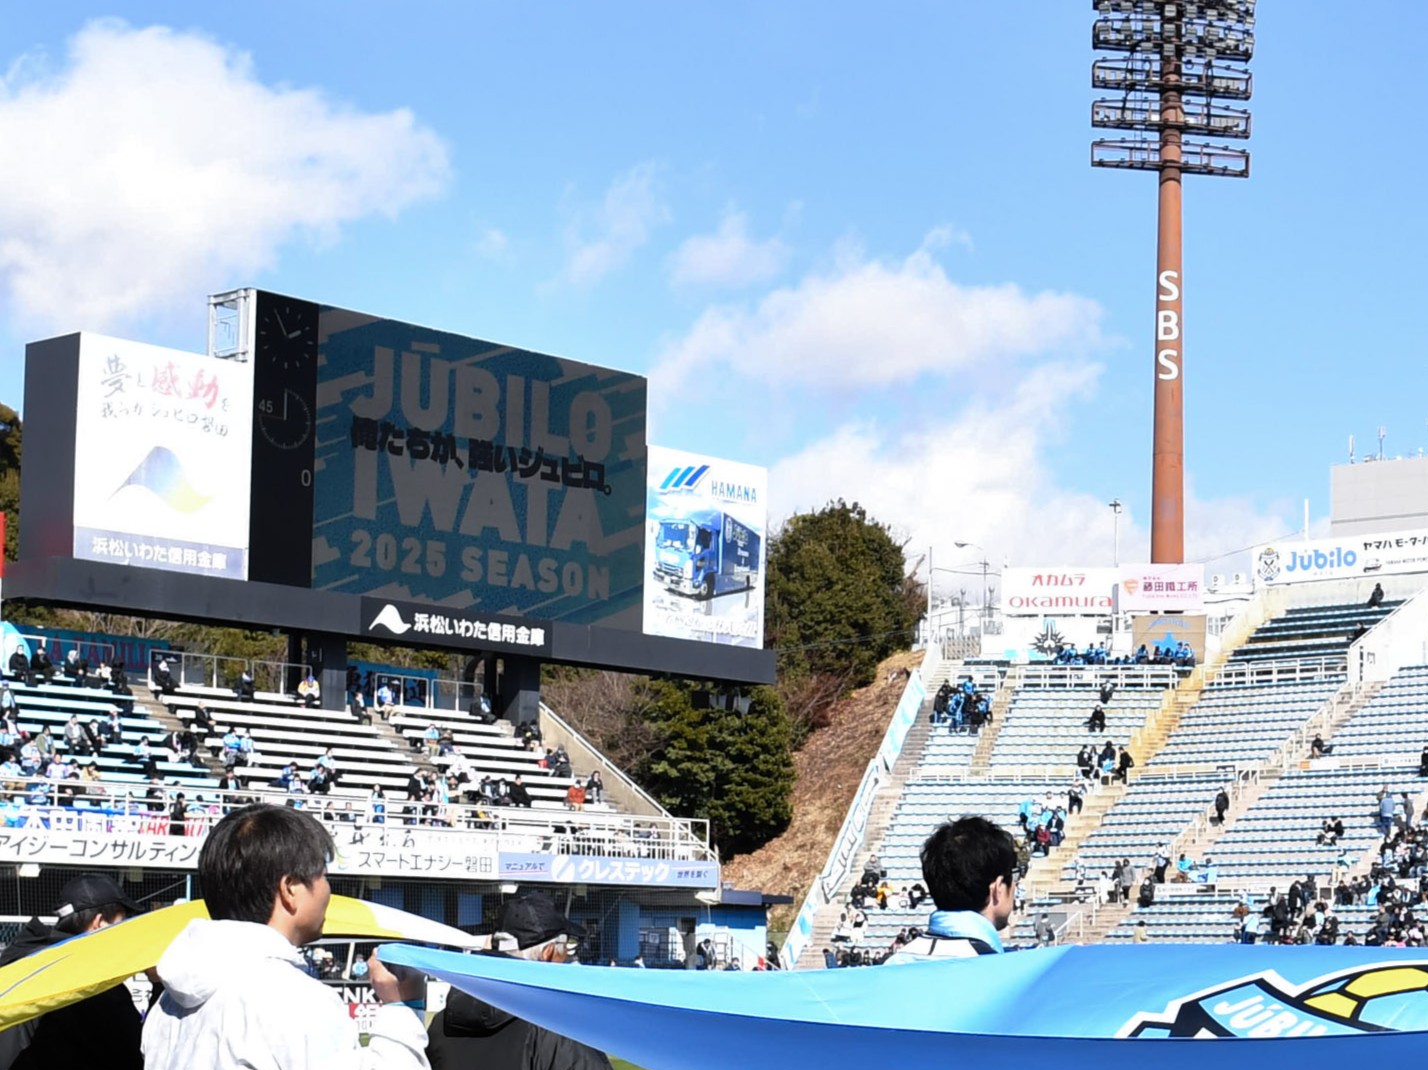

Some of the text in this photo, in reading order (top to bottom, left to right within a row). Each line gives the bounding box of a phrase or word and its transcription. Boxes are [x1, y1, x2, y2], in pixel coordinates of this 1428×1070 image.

[1158, 270, 1179, 381] SBS
[259, 400, 273, 413] 45
[352, 415, 612, 496] 俺たちが、強いジュビロ。
[301, 470, 310, 487] 0
[353, 446, 609, 556] IWATA
[711, 481, 758, 503] HAMANA
[92, 537, 227, 570] 浜松いわた信用金庫
[1363, 540, 1392, 551] ヤマハ
[351, 530, 610, 601] 2025 SEASON
[1031, 573, 1086, 587] オカムラ
[413, 613, 545, 646] 浜松いわた信用金庫
[0, 834, 198, 863] アイジーコンサルティン
[358, 851, 493, 873] スマートエナジー磐田
[578, 858, 670, 882] クレステック
